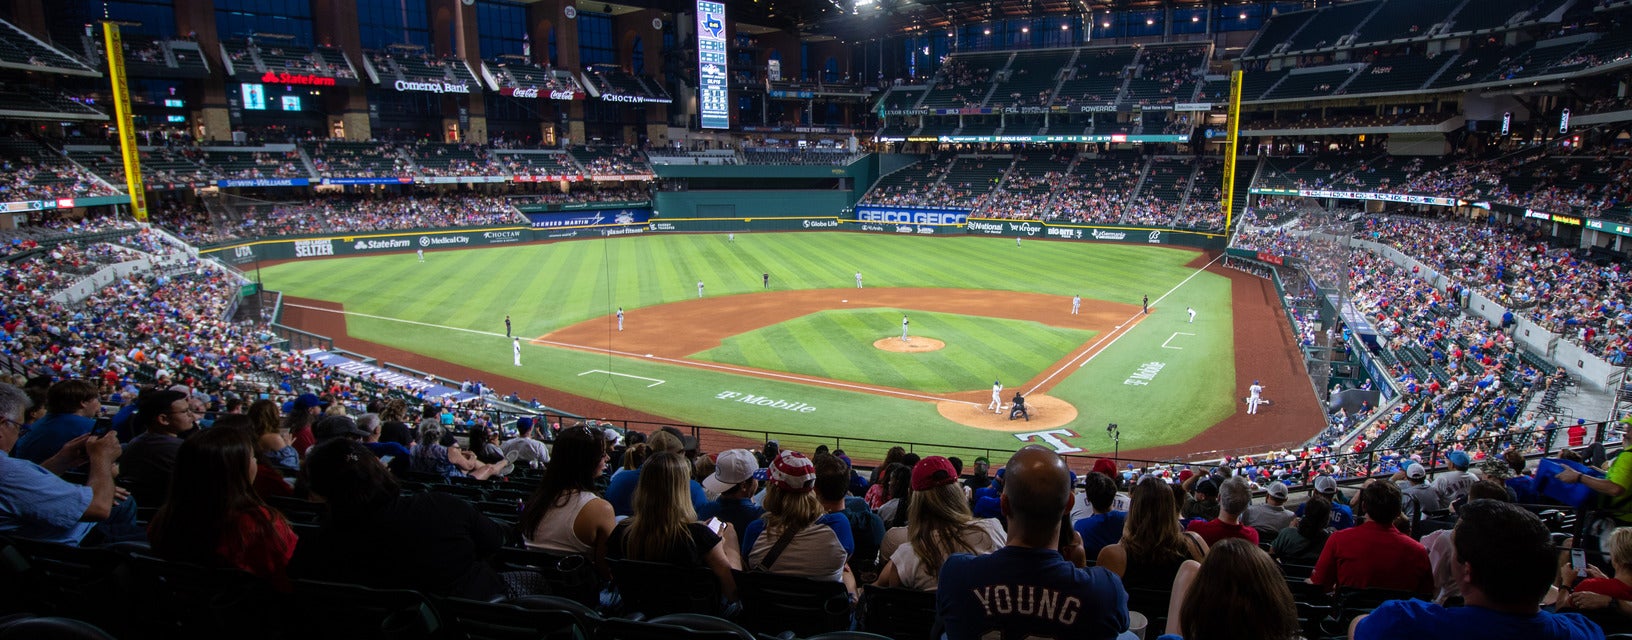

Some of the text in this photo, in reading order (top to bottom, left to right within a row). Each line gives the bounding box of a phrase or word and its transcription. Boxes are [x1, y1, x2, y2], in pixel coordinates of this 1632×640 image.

[444, 83, 470, 93] Bank
[513, 87, 539, 98] Coca-Cola
[551, 90, 575, 100] Coca-Cola
[606, 93, 644, 103] CHOCTAW
[858, 210, 967, 225] GEICO GEICO
[975, 221, 1003, 231] National
[1019, 222, 1041, 236] Kroger
[488, 231, 520, 239] CHOCTAW
[607, 228, 624, 236] planet
[367, 239, 411, 249] State Farm
[431, 236, 469, 245] Medical City
[235, 245, 252, 258] UTA
[295, 244, 334, 257] SELTZER
[736, 394, 817, 413] Mobile
[974, 584, 1081, 625] YOUNG
